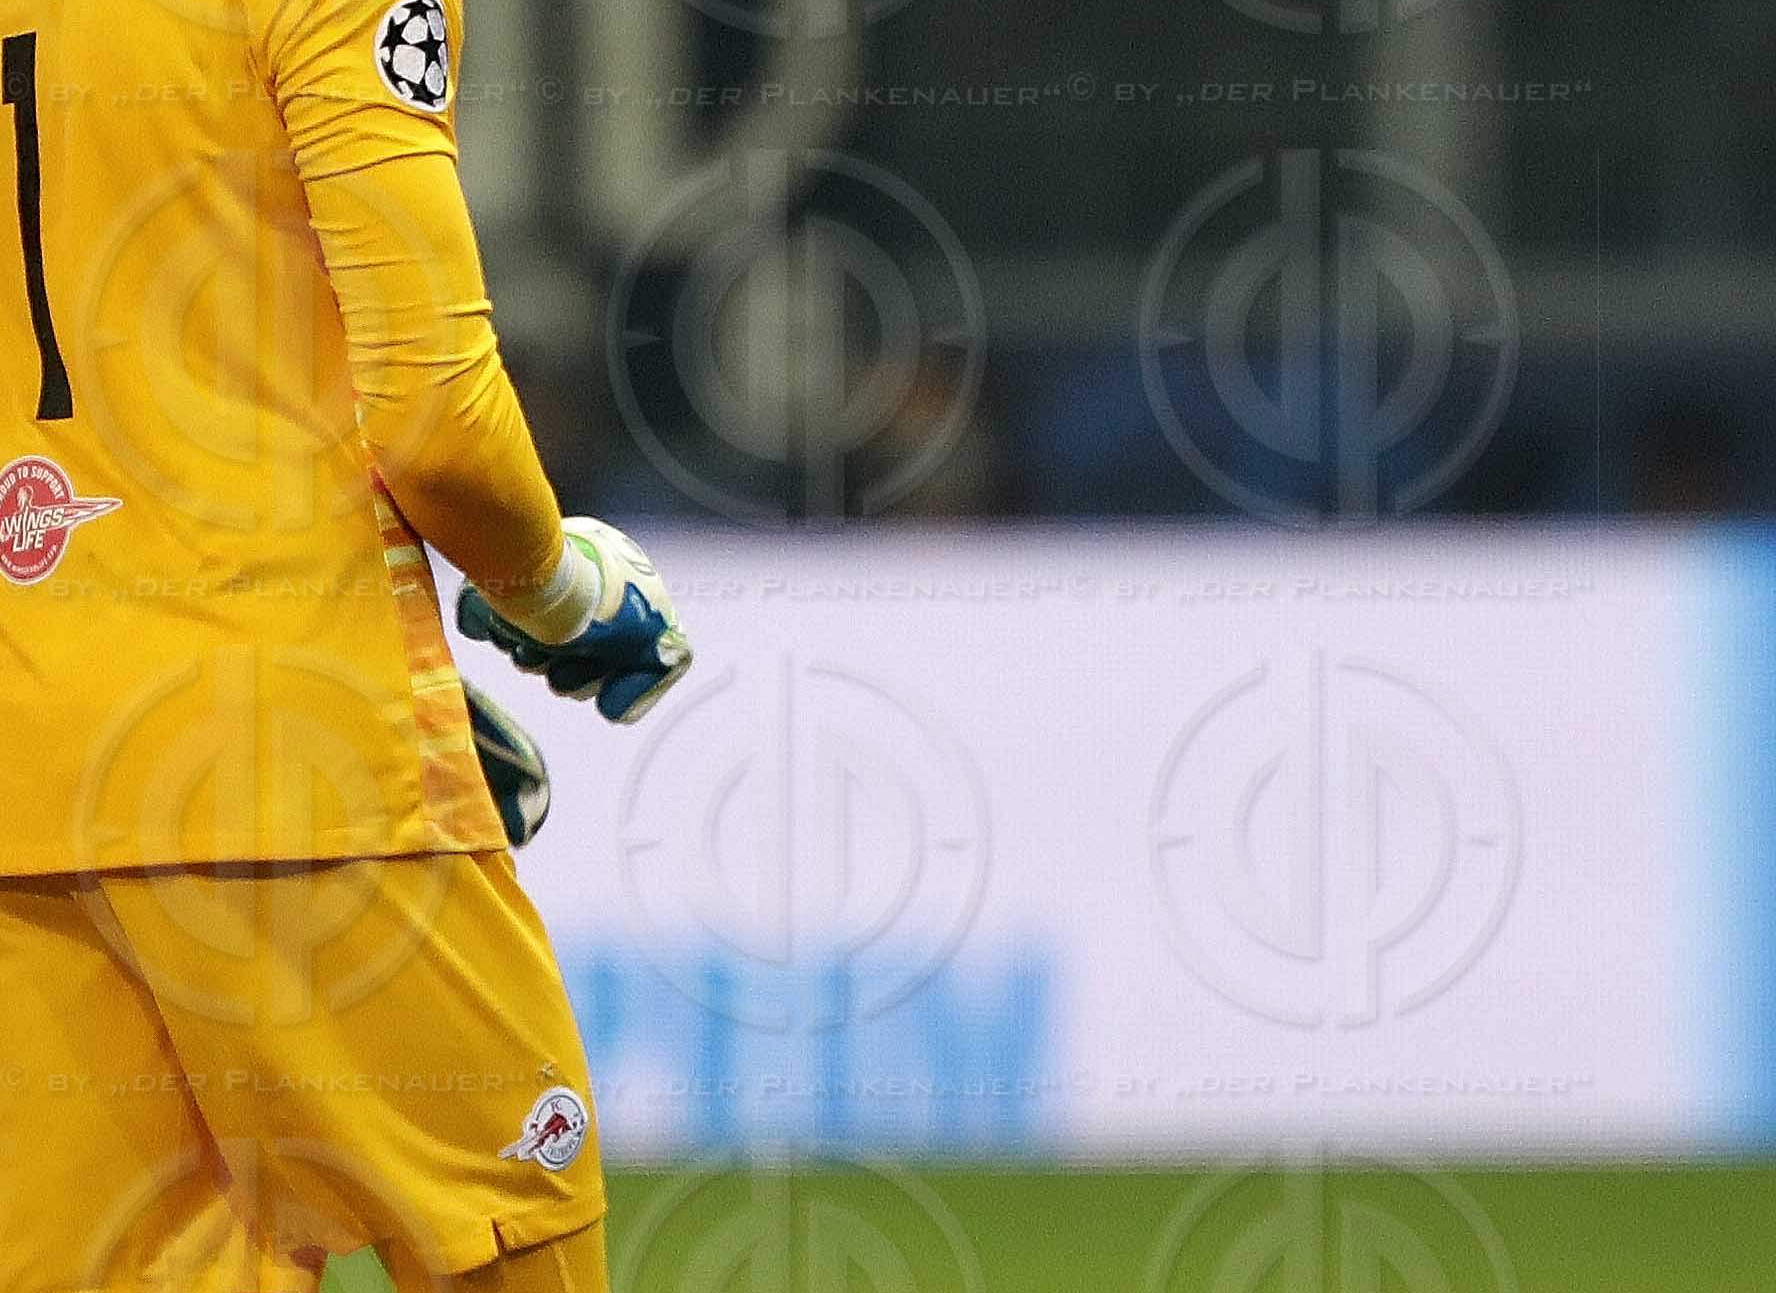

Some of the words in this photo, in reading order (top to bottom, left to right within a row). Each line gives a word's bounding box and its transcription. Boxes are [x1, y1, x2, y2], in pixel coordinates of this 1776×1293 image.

[1, 32, 73, 419] 1
[16, 465, 29, 481] TO
[30, 465, 65, 502] SUPPORT
[3, 507, 65, 537] WINGS
[12, 528, 46, 553] LIFE
